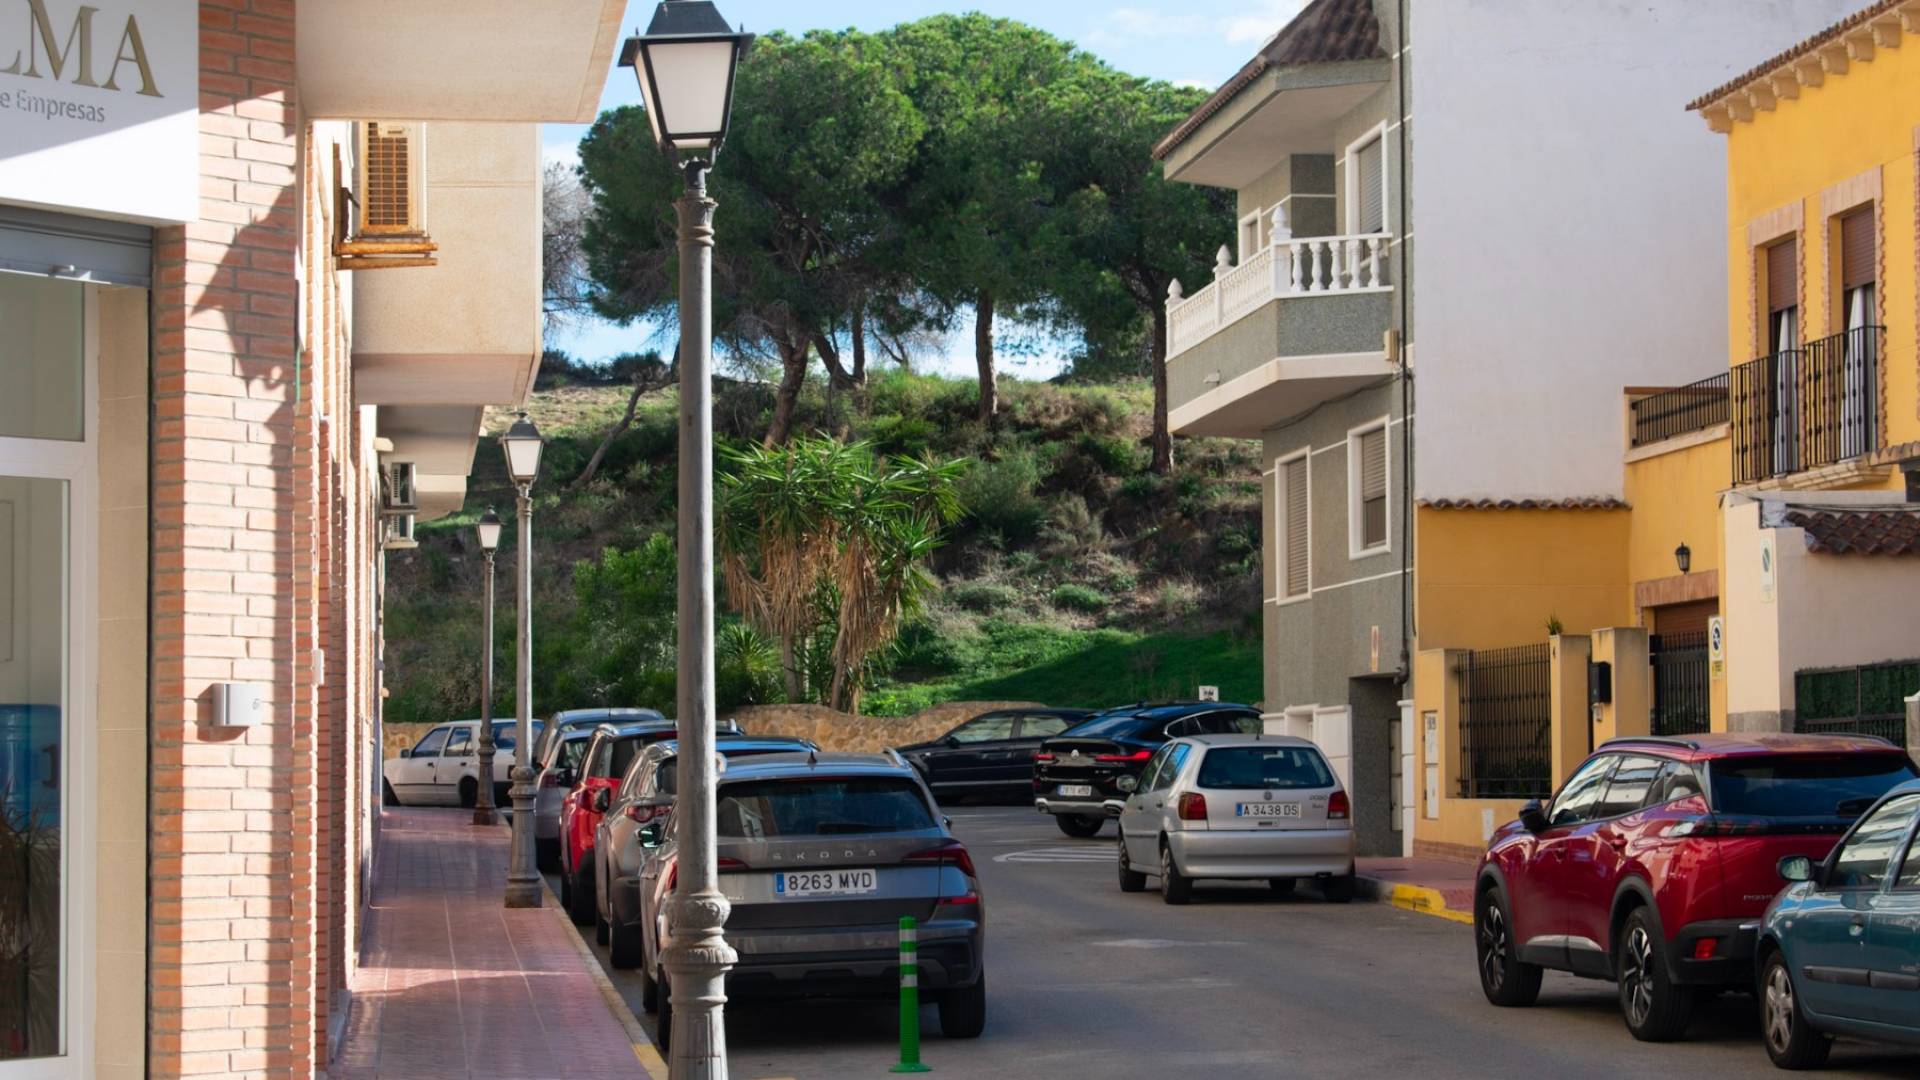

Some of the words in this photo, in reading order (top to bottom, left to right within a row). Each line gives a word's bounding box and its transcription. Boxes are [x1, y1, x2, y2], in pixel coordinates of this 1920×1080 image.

[16, 89, 105, 123] Empresas
[1243, 804, 1250, 816] A
[1253, 804, 1281, 816] 3438
[1283, 804, 1298, 816] DS
[788, 874, 833, 891] 8263
[839, 872, 872, 889] MVD
